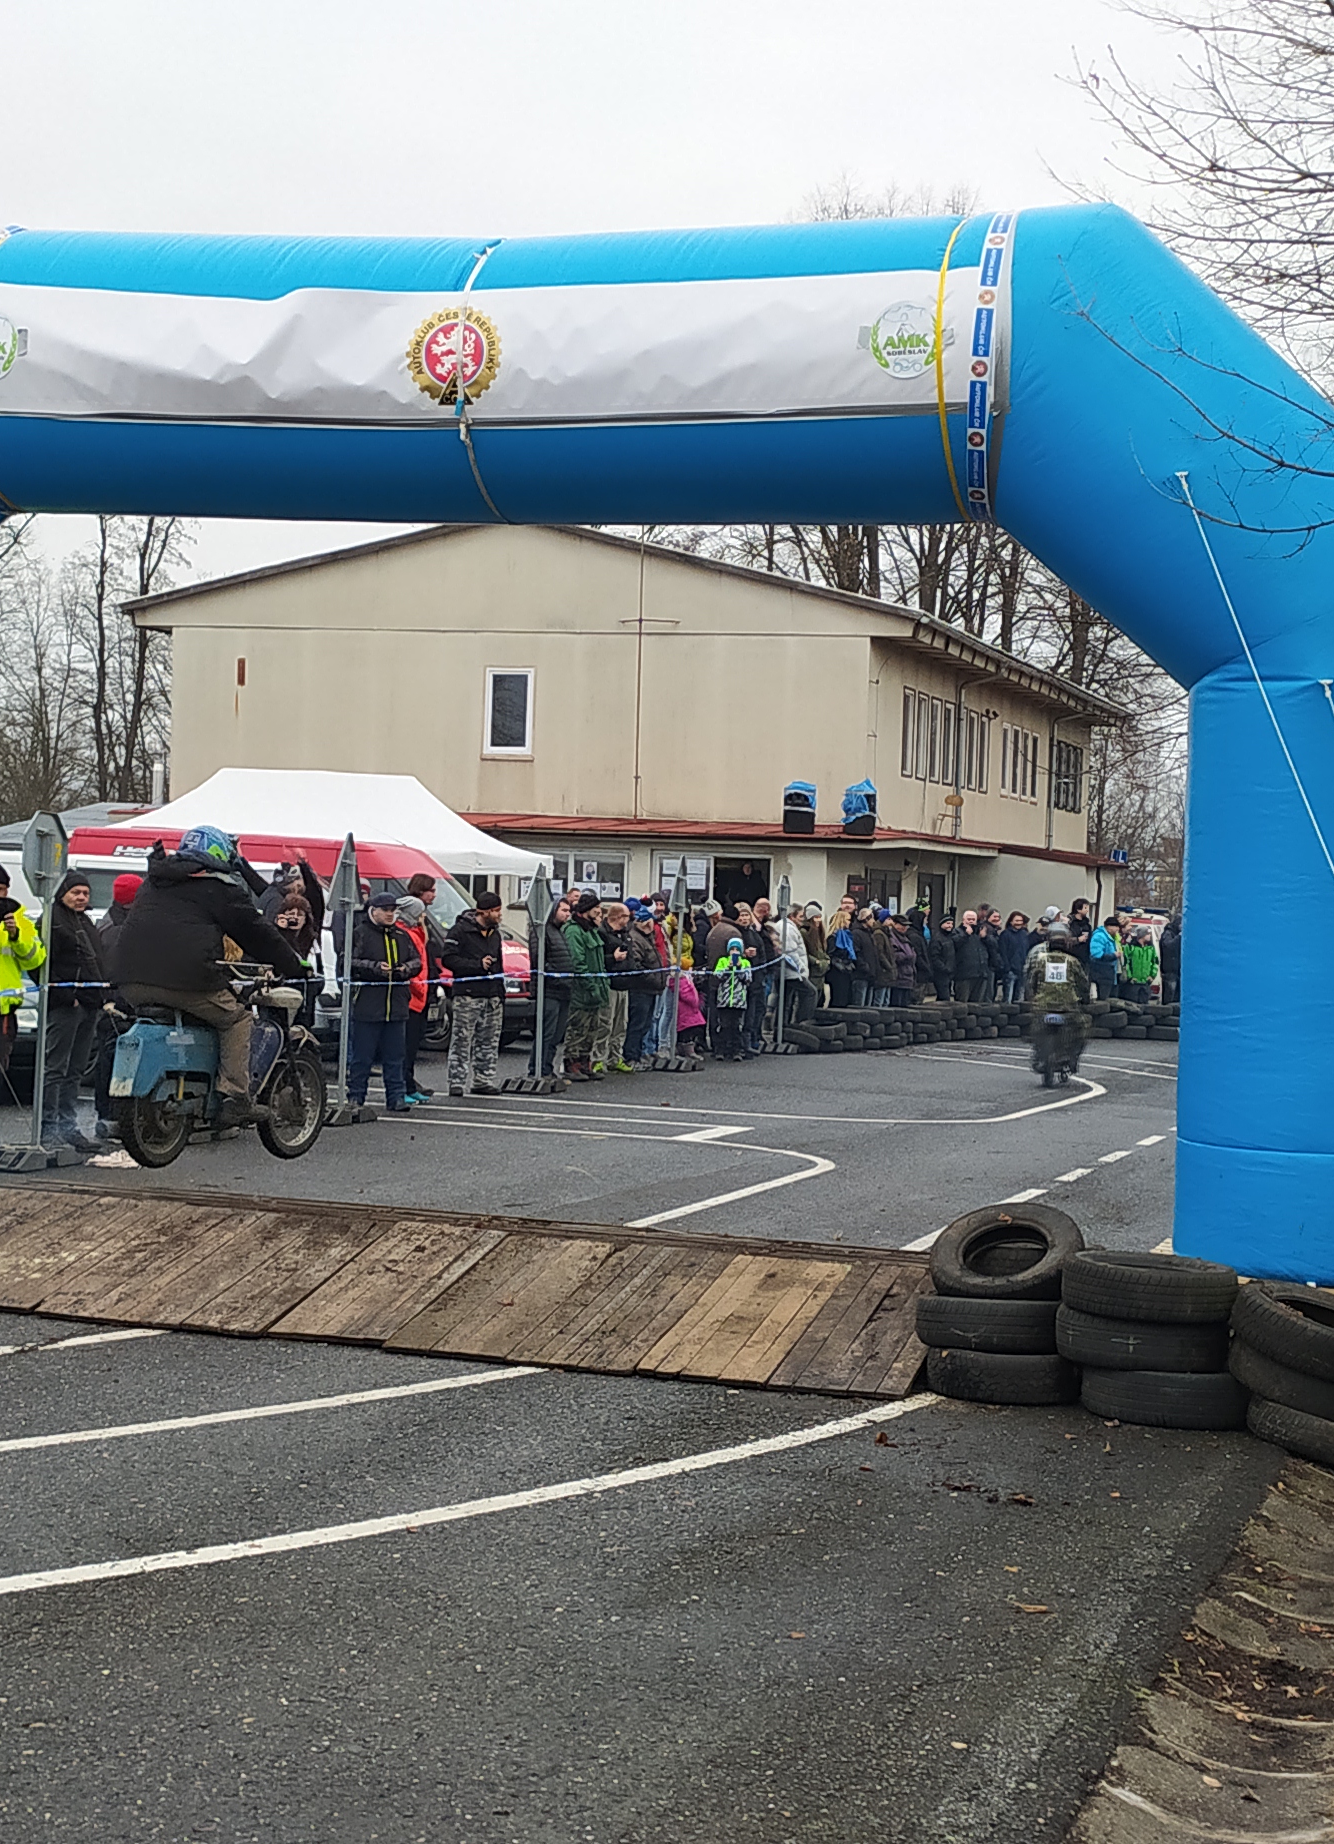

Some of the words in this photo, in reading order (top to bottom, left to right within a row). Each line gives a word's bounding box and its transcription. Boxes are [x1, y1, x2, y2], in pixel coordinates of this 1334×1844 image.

[413, 321, 436, 375] AUTOKLUB
[437, 311, 474, 323] ČESÉ
[473, 315, 498, 373] REPUBLIKY
[883, 333, 930, 350] AMK
